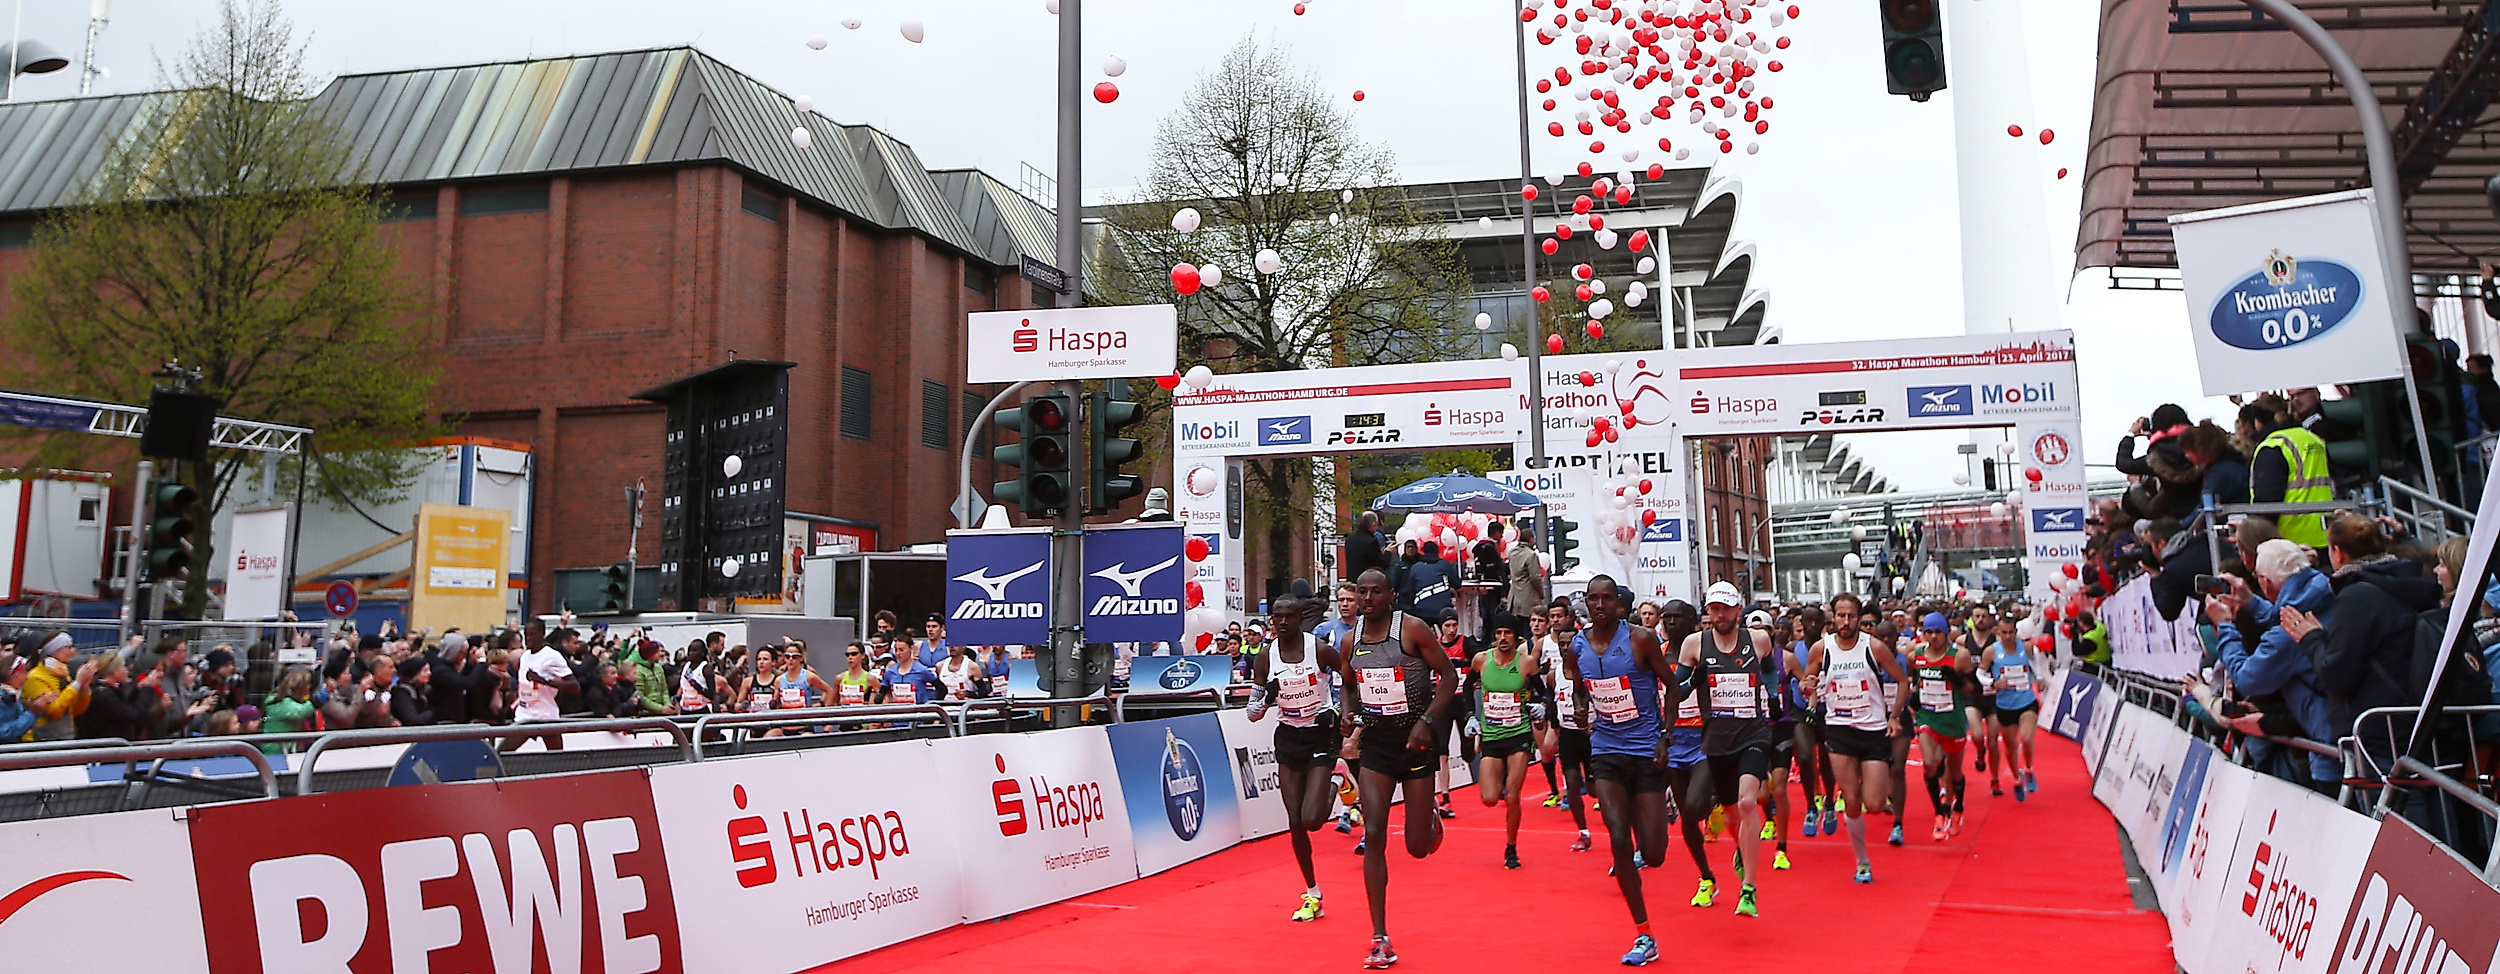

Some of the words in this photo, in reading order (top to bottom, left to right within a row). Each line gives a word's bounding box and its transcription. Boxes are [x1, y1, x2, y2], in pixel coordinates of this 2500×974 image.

[2234, 283, 2337, 314] Krombacher
[2261, 307, 2323, 345] 0,0%
[1049, 327, 1128, 355] Haspa
[1048, 359, 1089, 369] Hamburger
[1090, 358, 1127, 367] Sparkasse
[1851, 361, 1867, 370] 32.
[1869, 359, 1899, 371] Haspa
[1901, 357, 1948, 368] Marathon
[1950, 355, 1996, 366] Hamburg
[2019, 351, 2043, 363] April
[2045, 350, 2069, 361] 2017
[1547, 371, 1604, 388] Hasa
[1177, 387, 1349, 406] WWW.HASPA-MARATHON-HAMBURG.DE
[1519, 391, 1608, 411] Marathon
[1981, 382, 2055, 404] Mobil
[1717, 396, 1778, 416] Haspa
[1449, 408, 1504, 428] Haspa
[1799, 408, 1885, 426] POLAR
[1181, 420, 1239, 441] Mobil
[1327, 429, 1401, 446] POLAR
[1181, 442, 1251, 451] BETRIEBSKRANKENKASSE
[1617, 451, 1673, 476] ZEL
[1505, 472, 1562, 491] Mobil
[2045, 482, 2082, 493] Haspa
[1548, 502, 1567, 512] spa
[1648, 497, 1681, 509] Haspa
[1192, 510, 1221, 521] Haspa
[2034, 544, 2079, 558] Mobil
[250, 555, 277, 572] Haspa
[1194, 565, 1214, 577] bil
[1637, 556, 1676, 569] Mobil
[1225, 576, 1240, 592] NEU
[1832, 661, 1865, 671] avacon
[1279, 689, 1315, 702] Kiprotich
[1370, 686, 1389, 695] Tola
[1712, 689, 1754, 698] Schöfisch
[1030, 774, 1103, 838] Haspa
[783, 806, 910, 880] Haspa
[1044, 850, 1081, 871] Hamburger
[1081, 844, 1110, 865] Sparkasse
[249, 815, 662, 974] REWE
[805, 897, 867, 927] Hamburger
[869, 884, 919, 916] Sparkasse
[2258, 851, 2318, 972] Haspa
